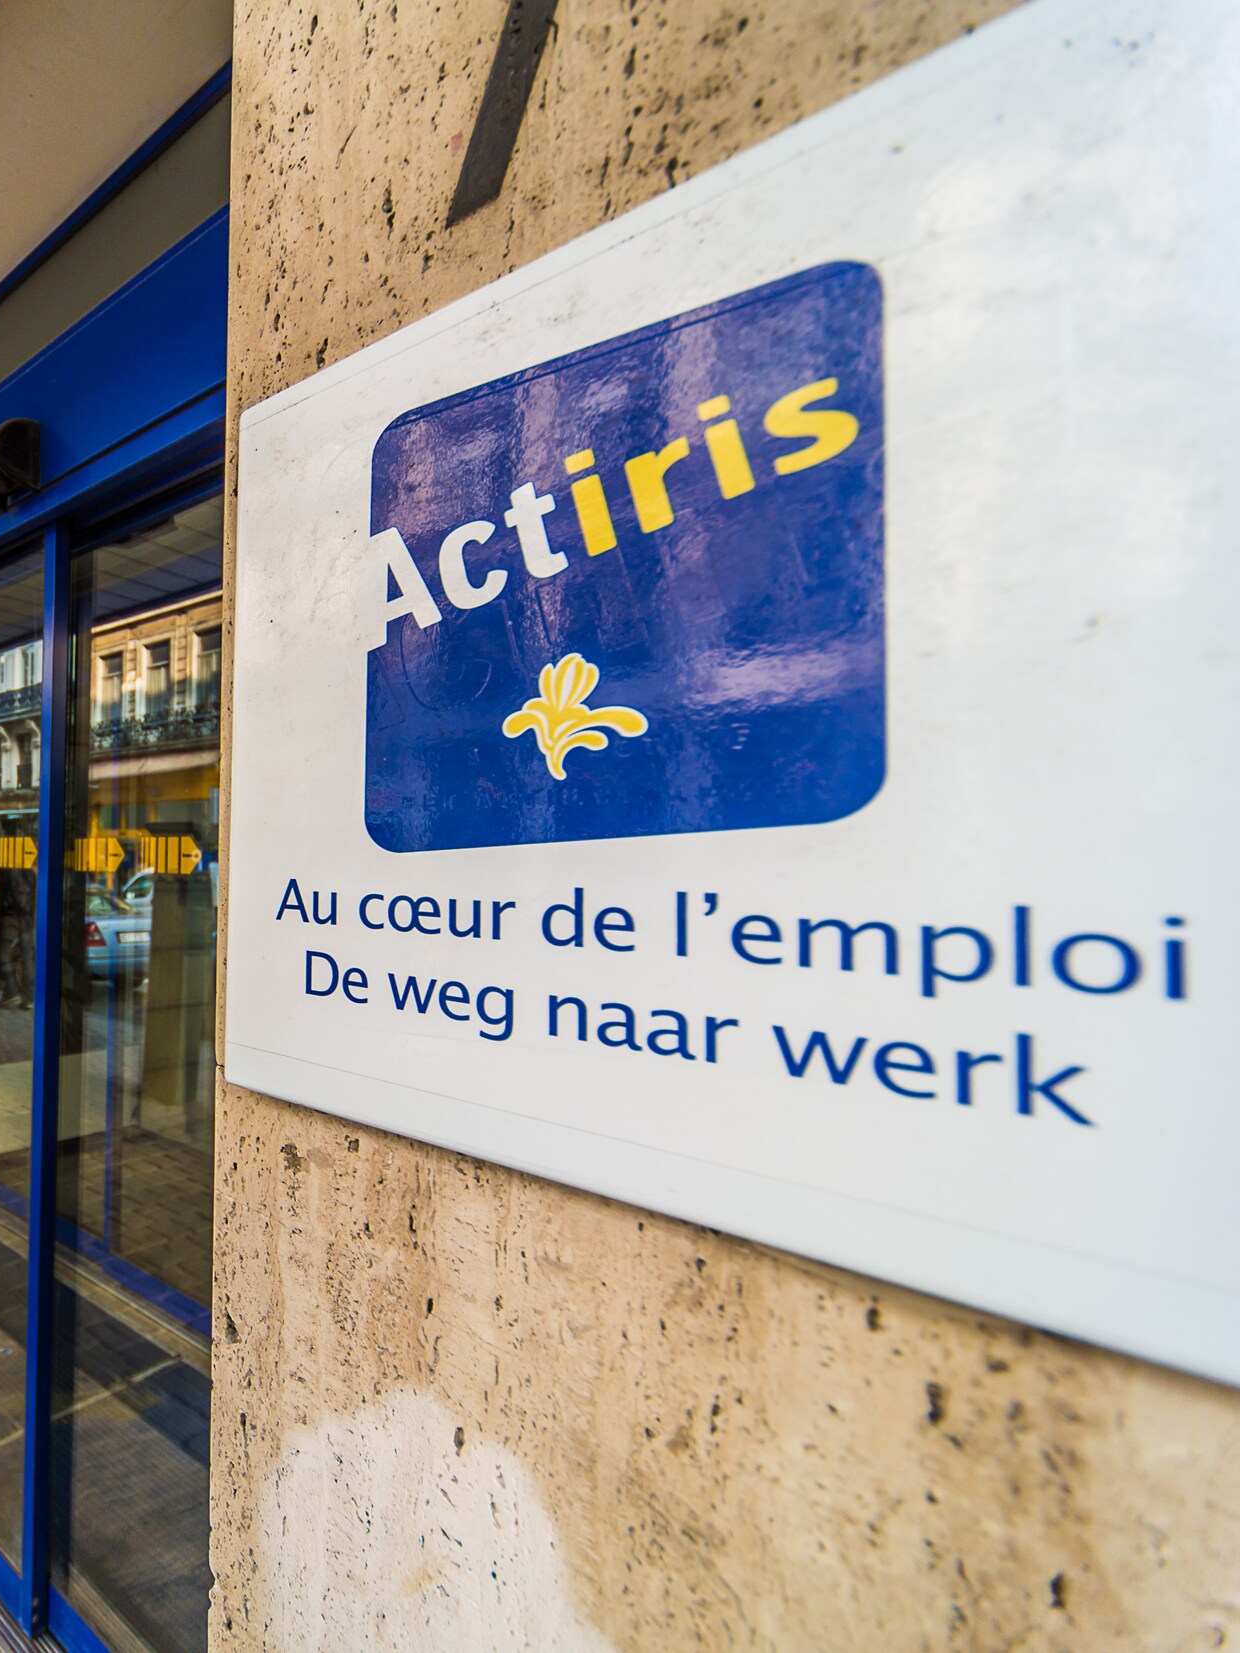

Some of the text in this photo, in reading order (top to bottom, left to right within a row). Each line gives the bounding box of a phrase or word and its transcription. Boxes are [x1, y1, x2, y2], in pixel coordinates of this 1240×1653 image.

[366, 377, 860, 652] Actiris
[275, 877, 1188, 1001] Au cœur de l’emploi
[304, 949, 1097, 1127] De weg naar werk
